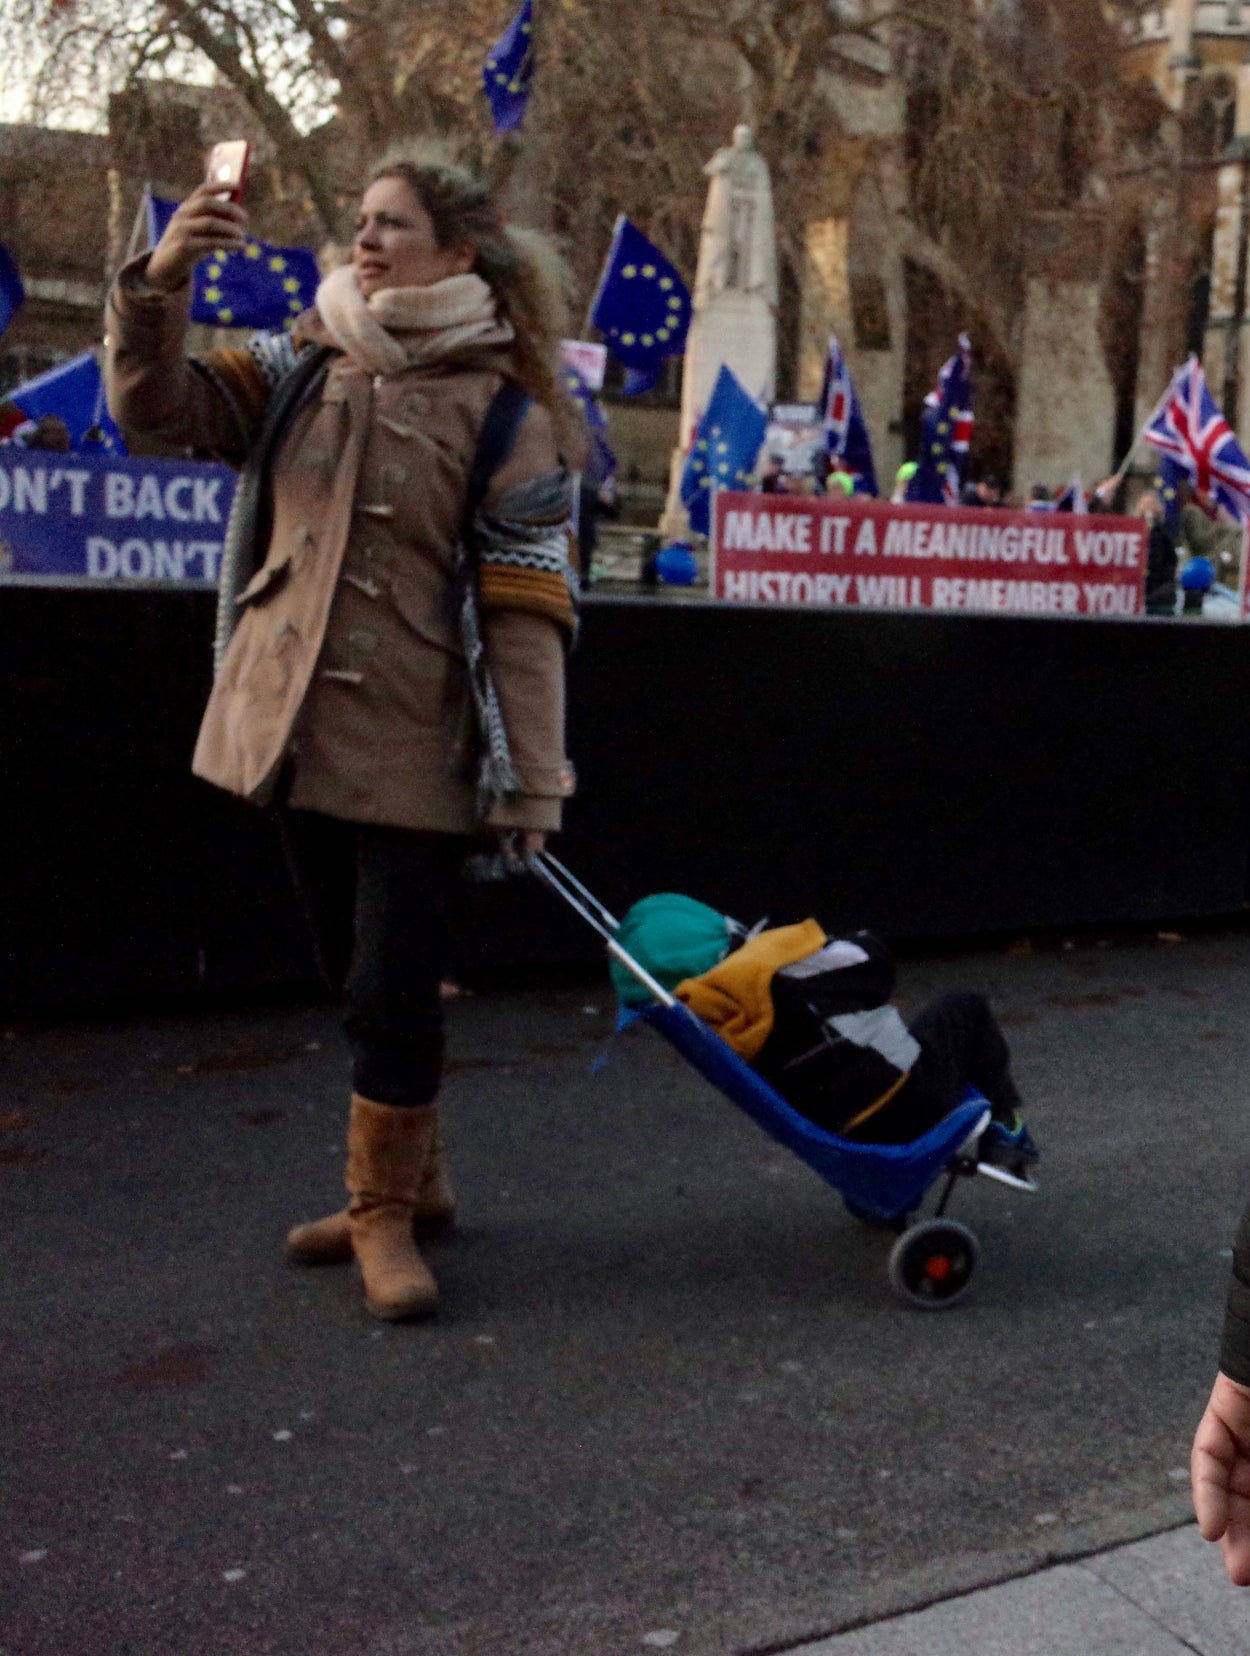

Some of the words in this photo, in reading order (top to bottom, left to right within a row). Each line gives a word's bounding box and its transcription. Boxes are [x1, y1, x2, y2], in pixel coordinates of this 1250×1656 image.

[105, 472, 223, 524] BACK
[85, 536, 223, 582] DON'T
[723, 510, 812, 553] MAKE
[819, 515, 851, 555] IT
[853, 517, 877, 556] A
[882, 520, 1069, 565] MEANINGFUL
[1071, 530, 1142, 567] VOTE
[723, 570, 851, 605] HISTORY
[855, 575, 922, 607] WILL
[931, 577, 1079, 613] REMEMBER
